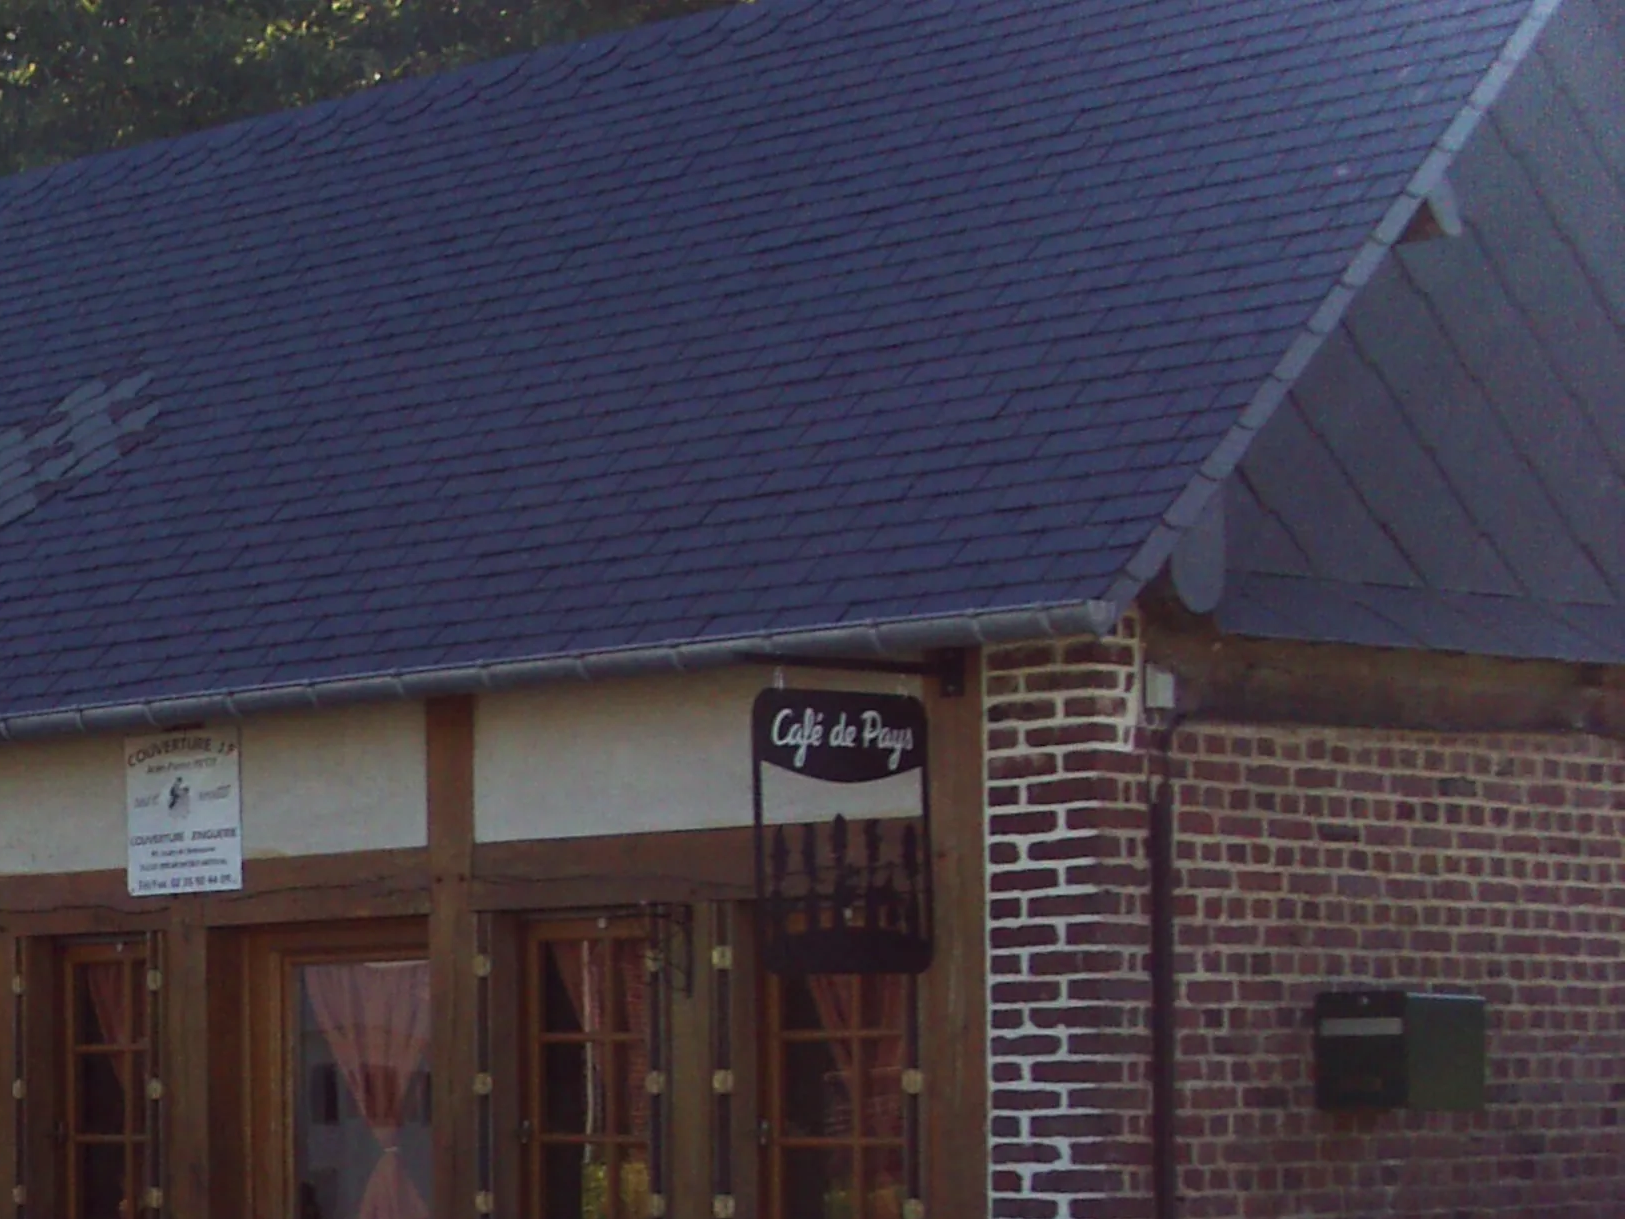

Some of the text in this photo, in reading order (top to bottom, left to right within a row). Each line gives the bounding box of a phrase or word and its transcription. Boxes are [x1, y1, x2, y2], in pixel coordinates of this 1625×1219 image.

[772, 707, 913, 771] Café de Pays
